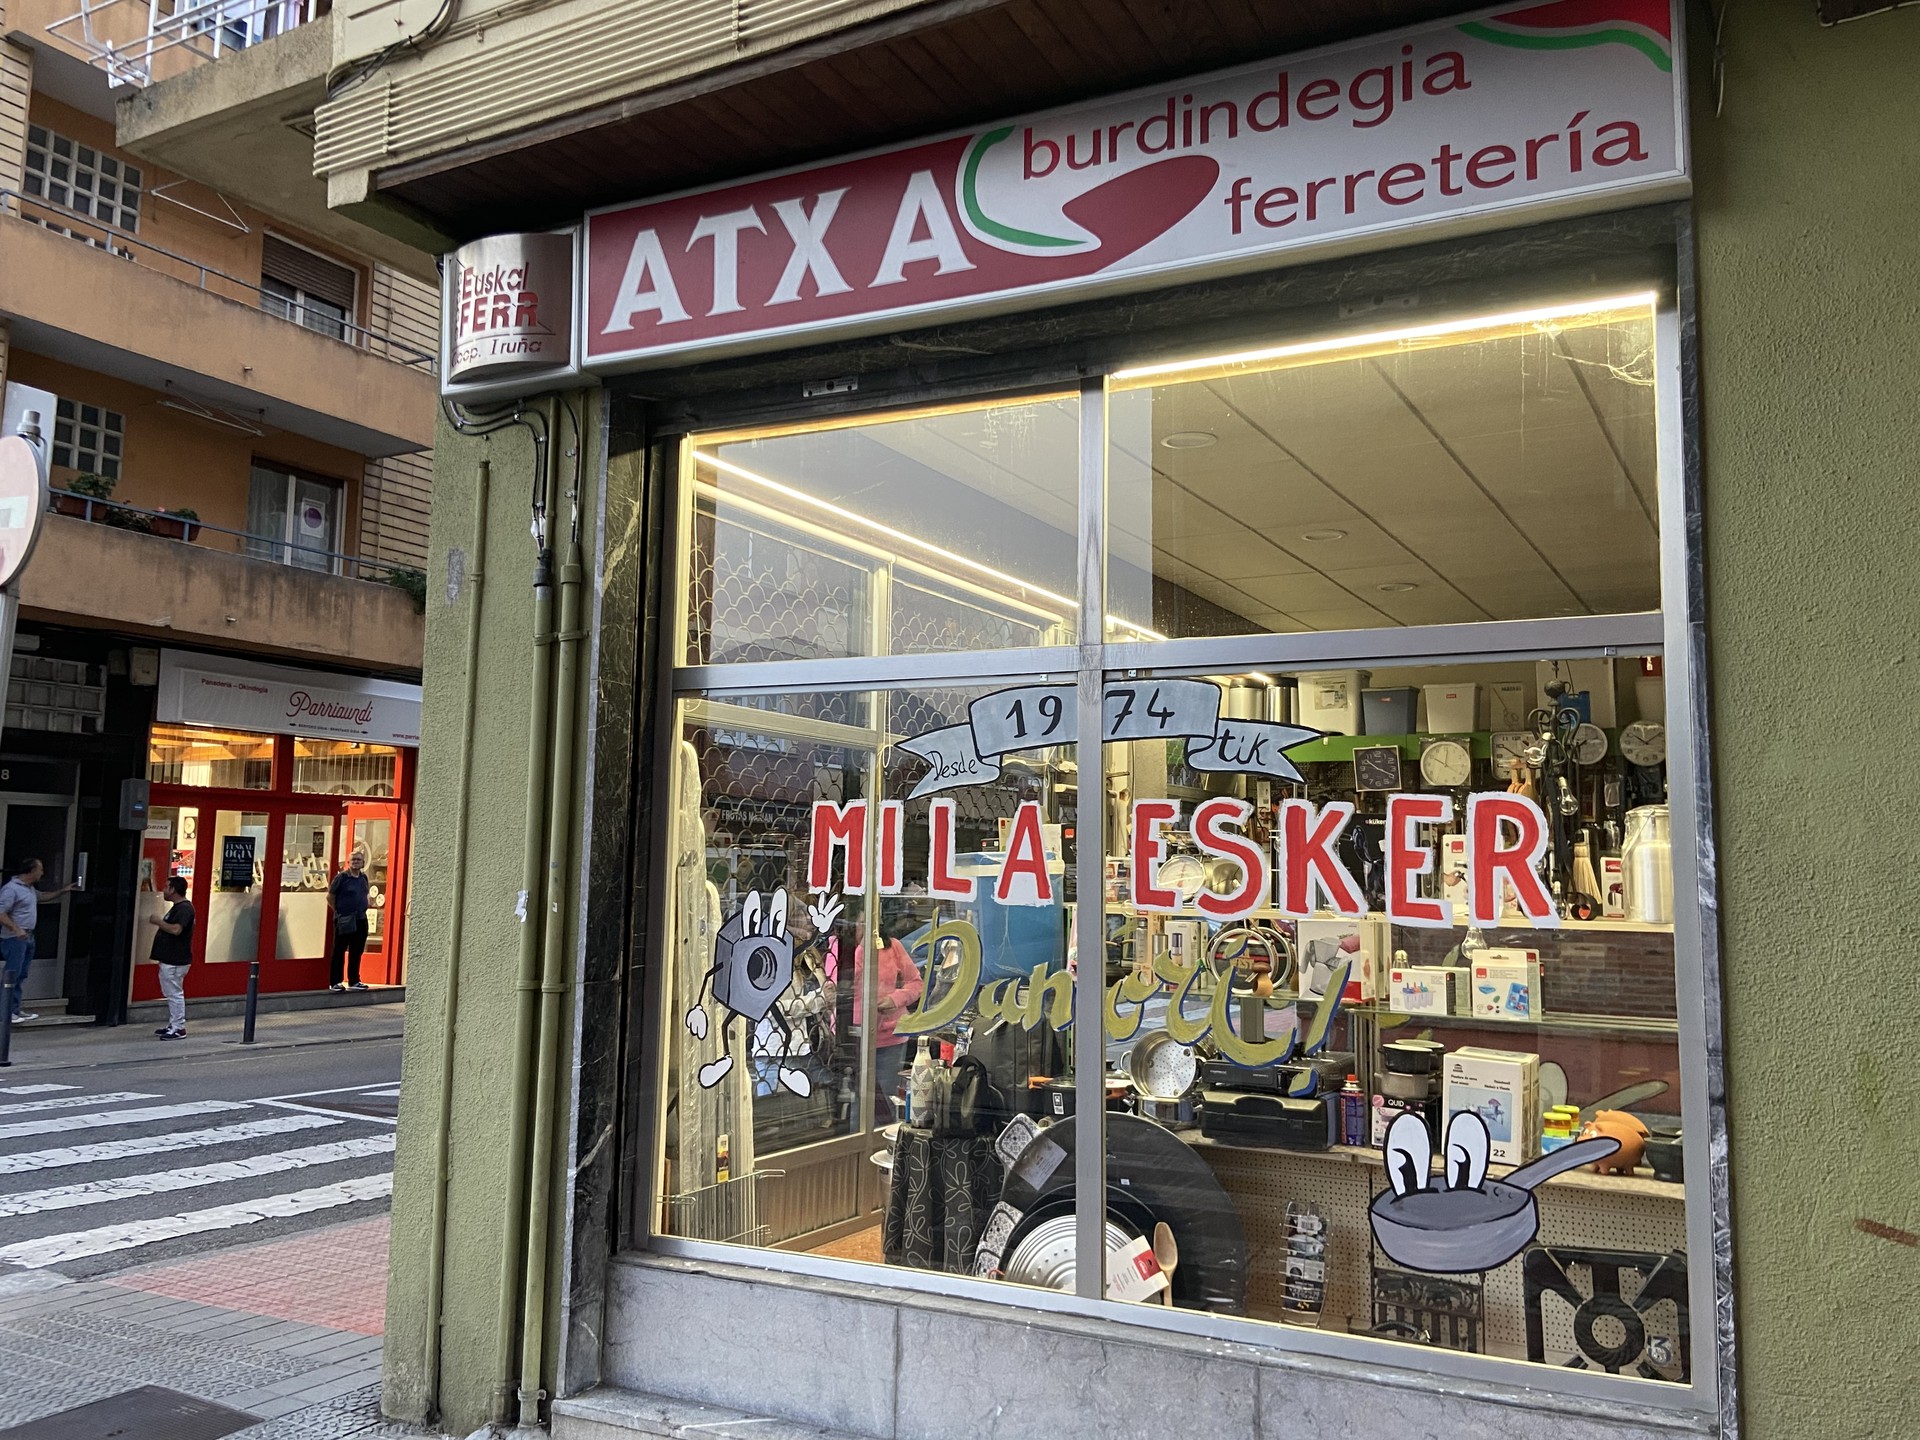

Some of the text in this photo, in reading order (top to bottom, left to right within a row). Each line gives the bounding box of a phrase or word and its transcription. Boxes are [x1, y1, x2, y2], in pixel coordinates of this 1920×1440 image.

[1022, 45, 1472, 181] burdindegia
[1224, 110, 1650, 236] ferretería
[462, 261, 530, 301] Euskal
[600, 168, 978, 336] ATXA
[459, 291, 539, 337] FERR
[286, 691, 373, 725] Parriaundi
[929, 749, 977, 781] Desde
[1004, 687, 1176, 739] 1974
[808, 791, 1560, 929] MILA ESKER
